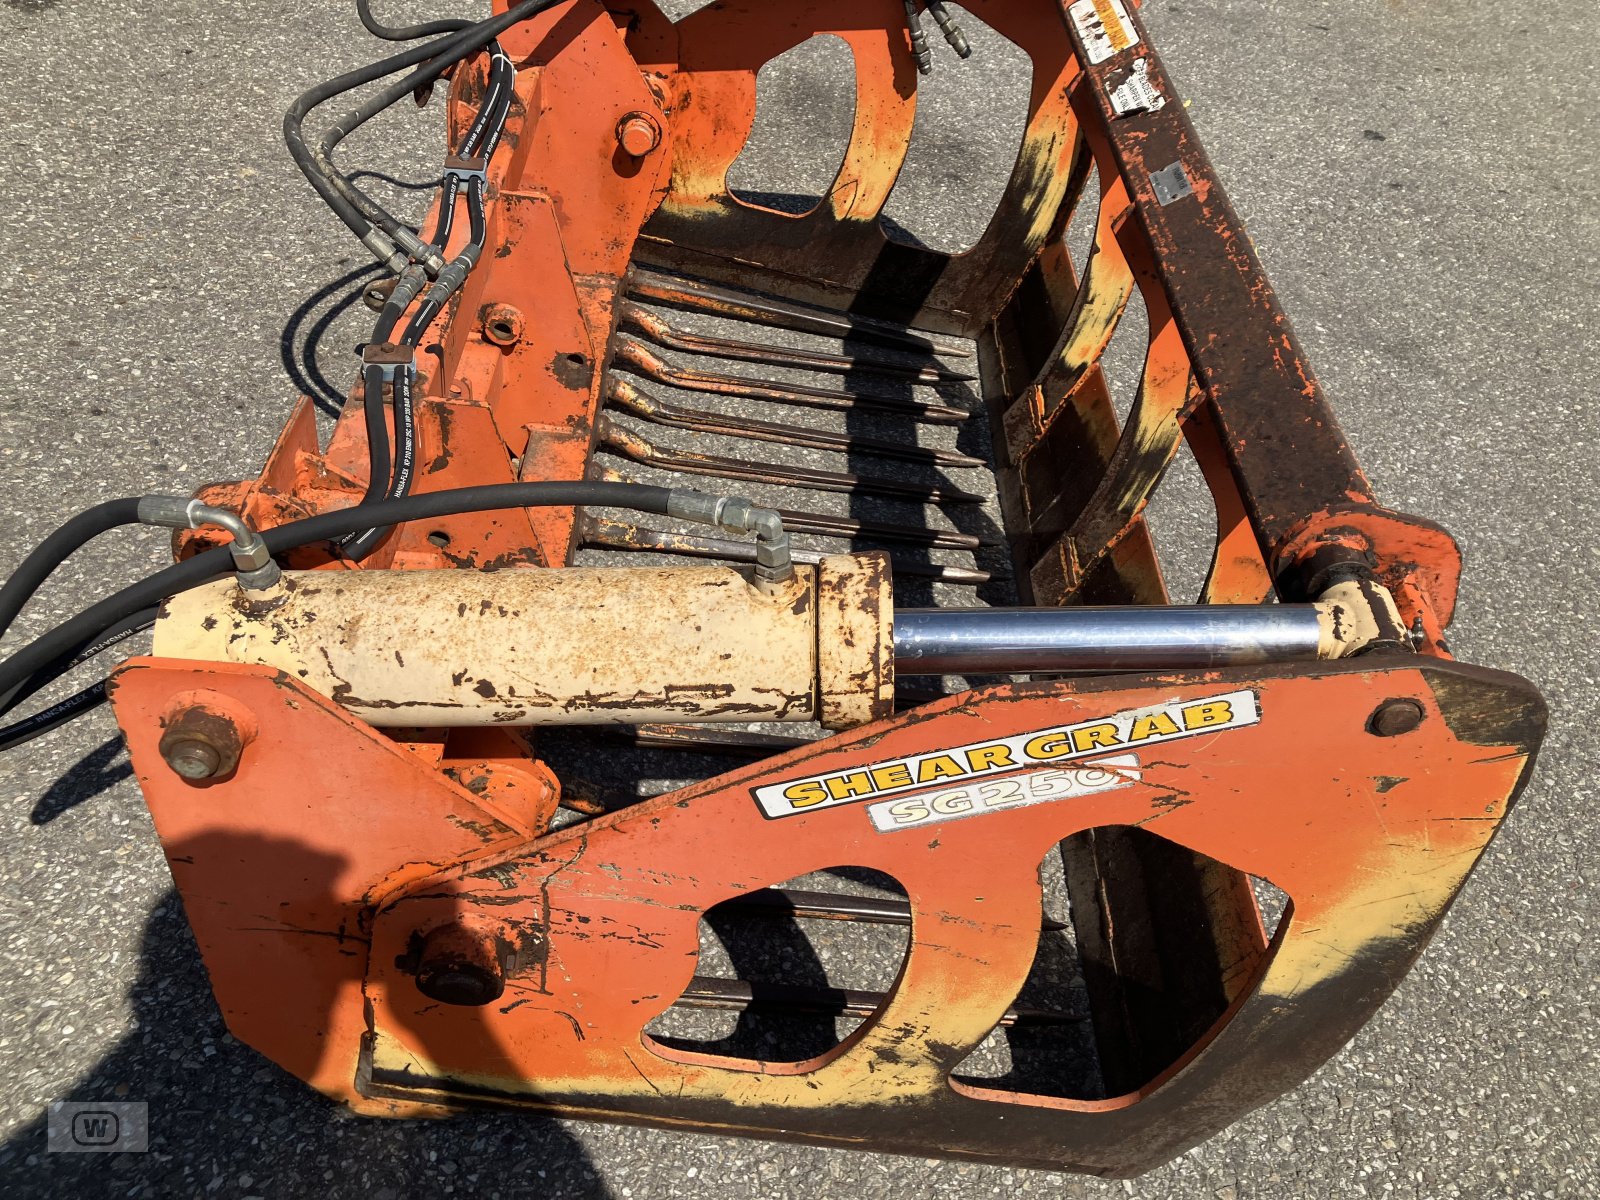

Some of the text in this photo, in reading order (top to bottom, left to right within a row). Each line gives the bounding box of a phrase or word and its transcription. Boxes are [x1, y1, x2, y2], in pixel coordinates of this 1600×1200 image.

[1116, 87, 1125, 100] FILE
[1126, 79, 1141, 102] SHARPEN
[394, 468, 409, 498] HANSA-FLEX
[83, 629, 133, 658] HANSA-FLEX
[35, 683, 104, 722] HANSA-FLEX KP
[783, 700, 1235, 809] SHEAR GRAB
[890, 764, 1121, 826] SG 250
